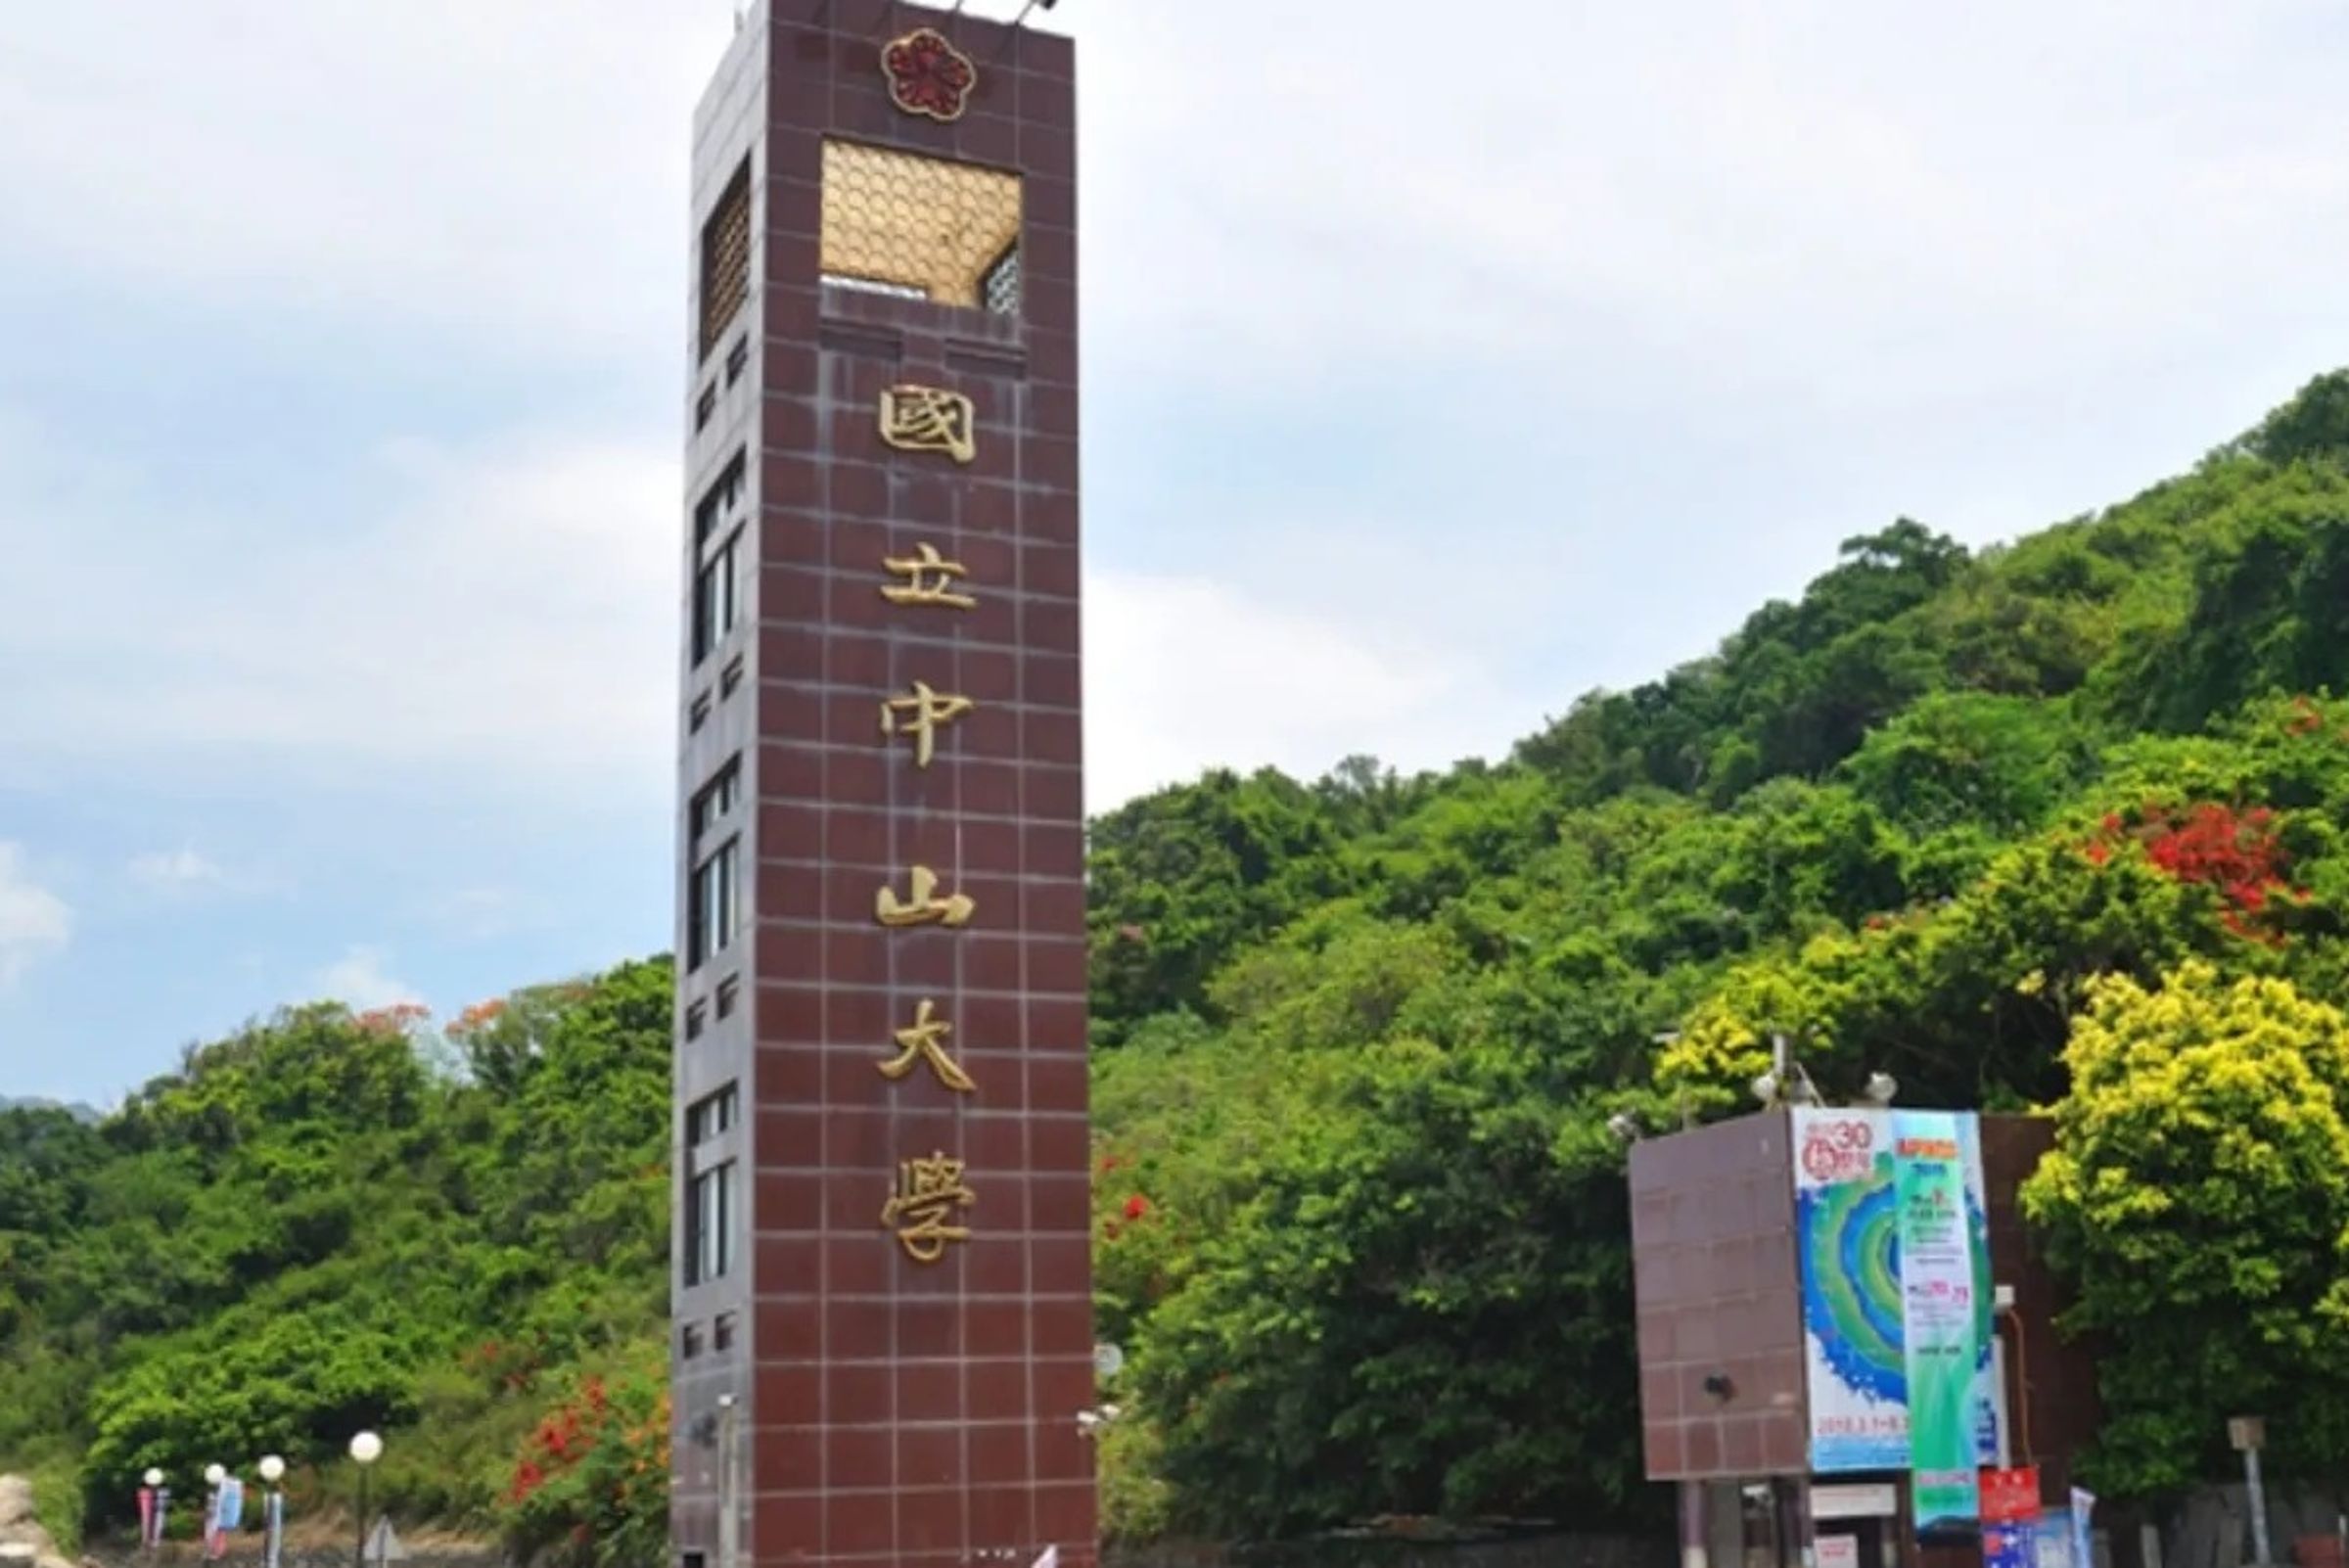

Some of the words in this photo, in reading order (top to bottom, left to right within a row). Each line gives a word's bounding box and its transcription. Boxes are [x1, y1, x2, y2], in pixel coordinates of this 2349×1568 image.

[876, 383, 978, 1262] 國立中山大學
